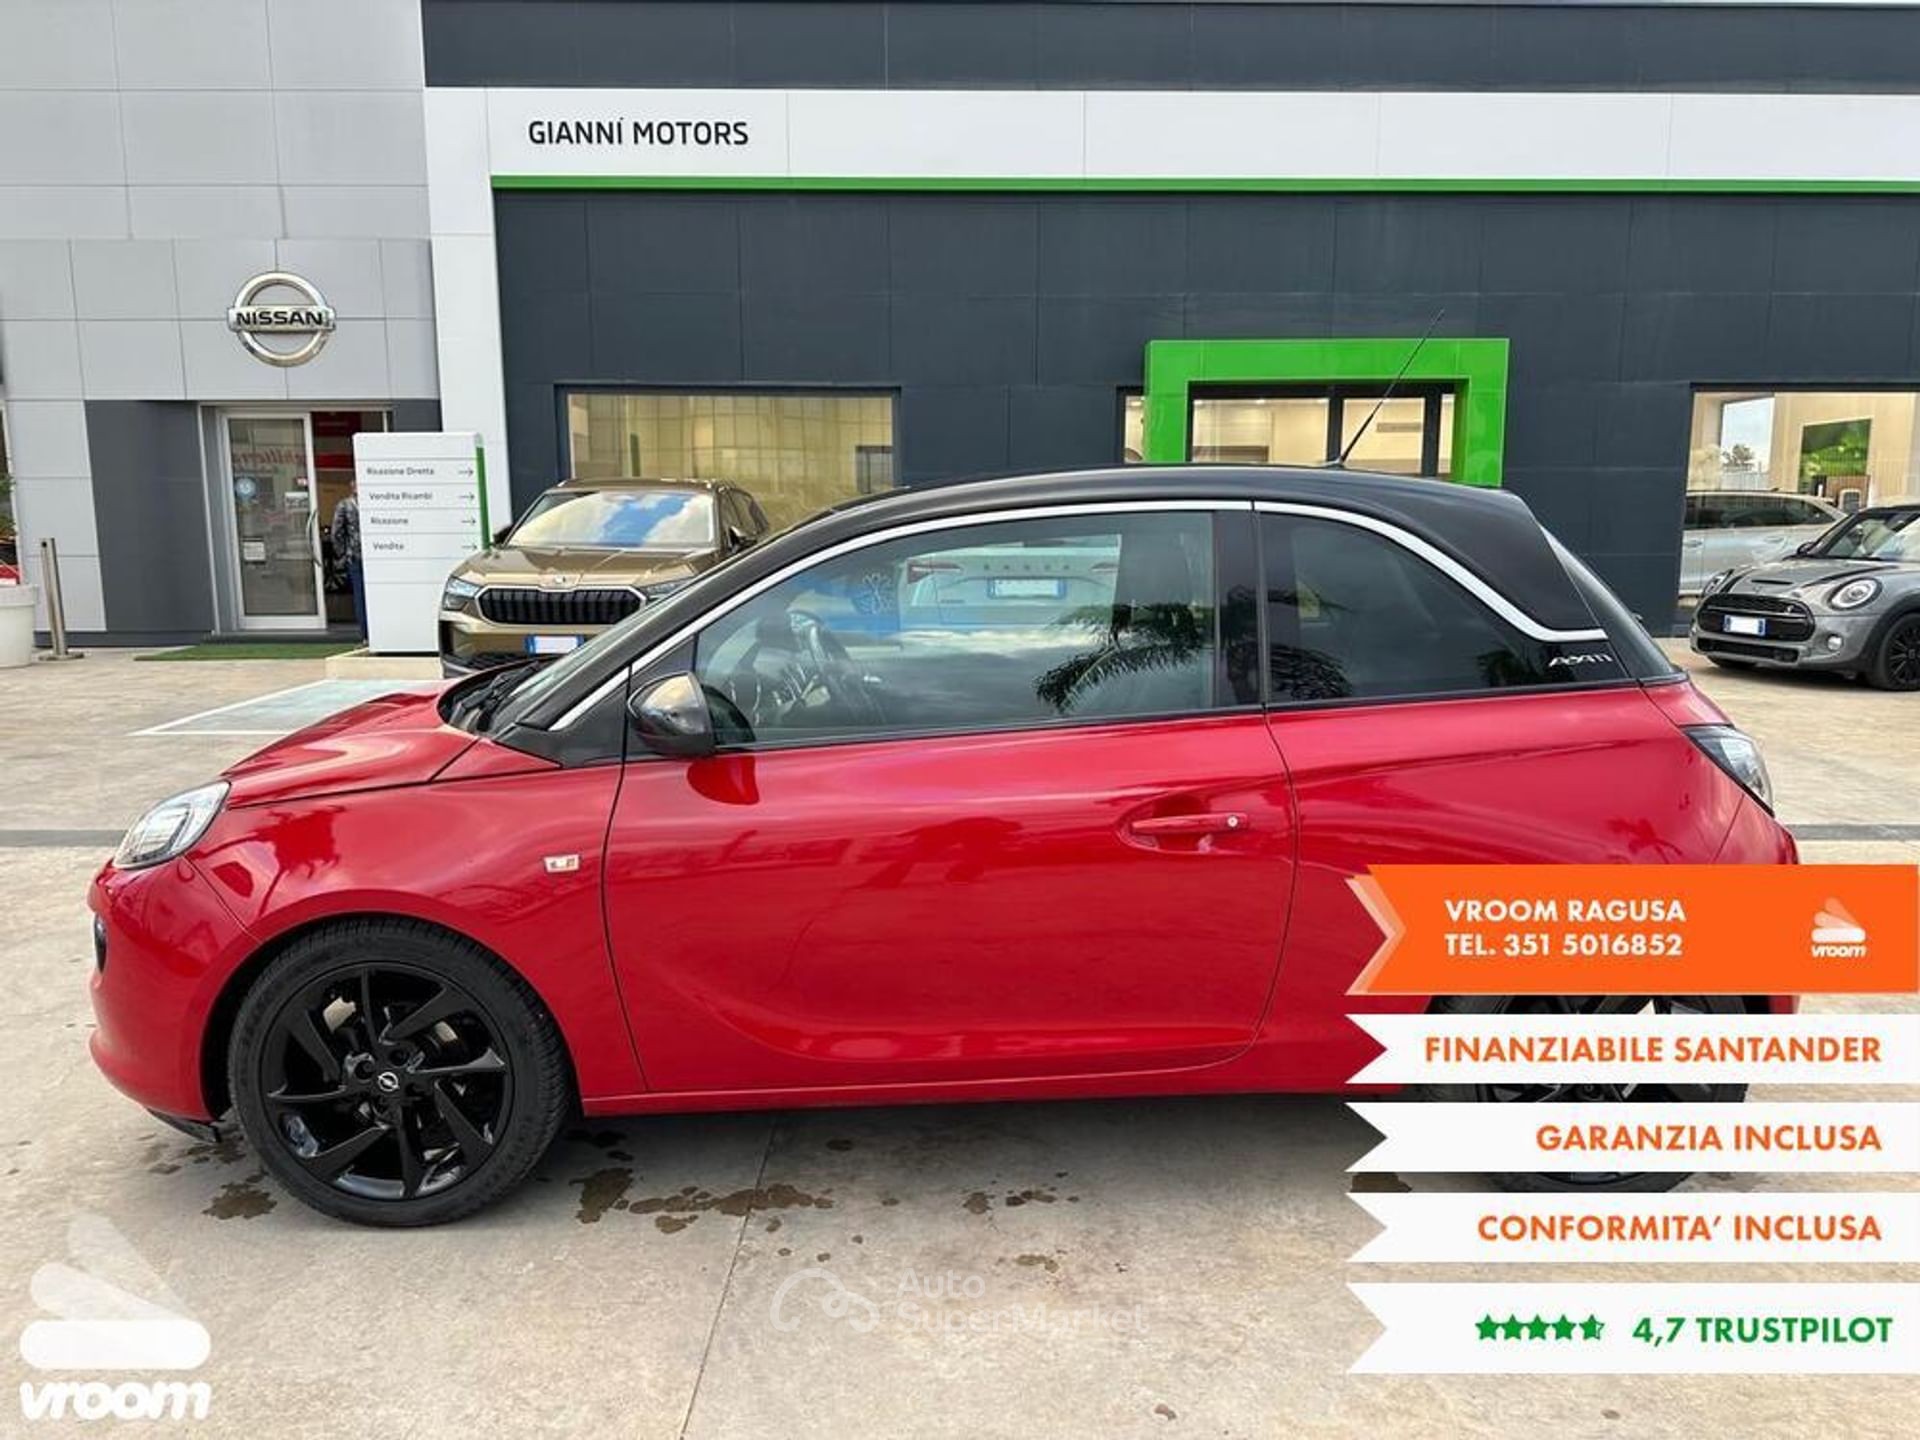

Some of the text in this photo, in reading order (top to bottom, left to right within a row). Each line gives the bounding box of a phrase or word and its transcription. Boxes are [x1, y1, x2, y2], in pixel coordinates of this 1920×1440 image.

[529, 116, 749, 146] GIANNÍ MOTORS
[236, 311, 323, 326] NISSAN
[369, 492, 400, 500] Vendita
